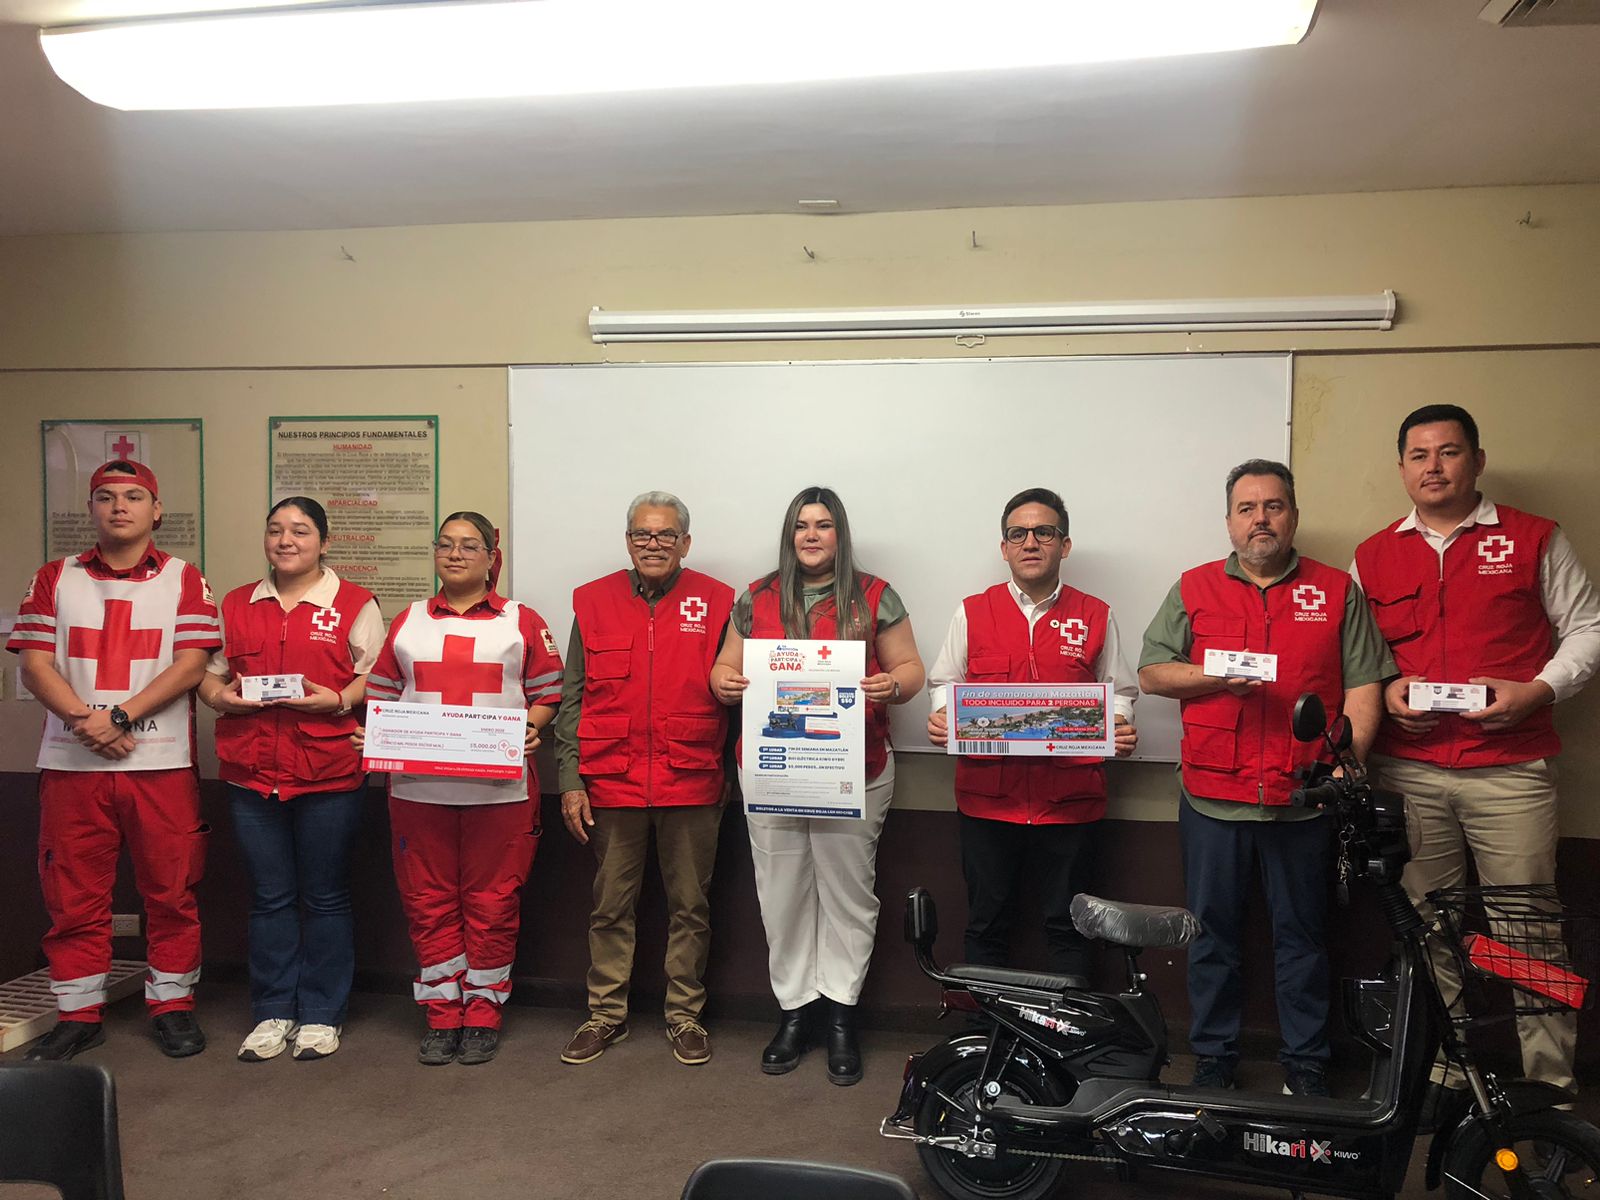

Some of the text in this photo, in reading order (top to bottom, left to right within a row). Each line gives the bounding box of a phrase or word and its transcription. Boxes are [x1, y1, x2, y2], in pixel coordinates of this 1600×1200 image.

[770, 662, 802, 671] GANA
[1244, 1132, 1306, 1158] Hikari
[1334, 1151, 1358, 1160] KIWO
